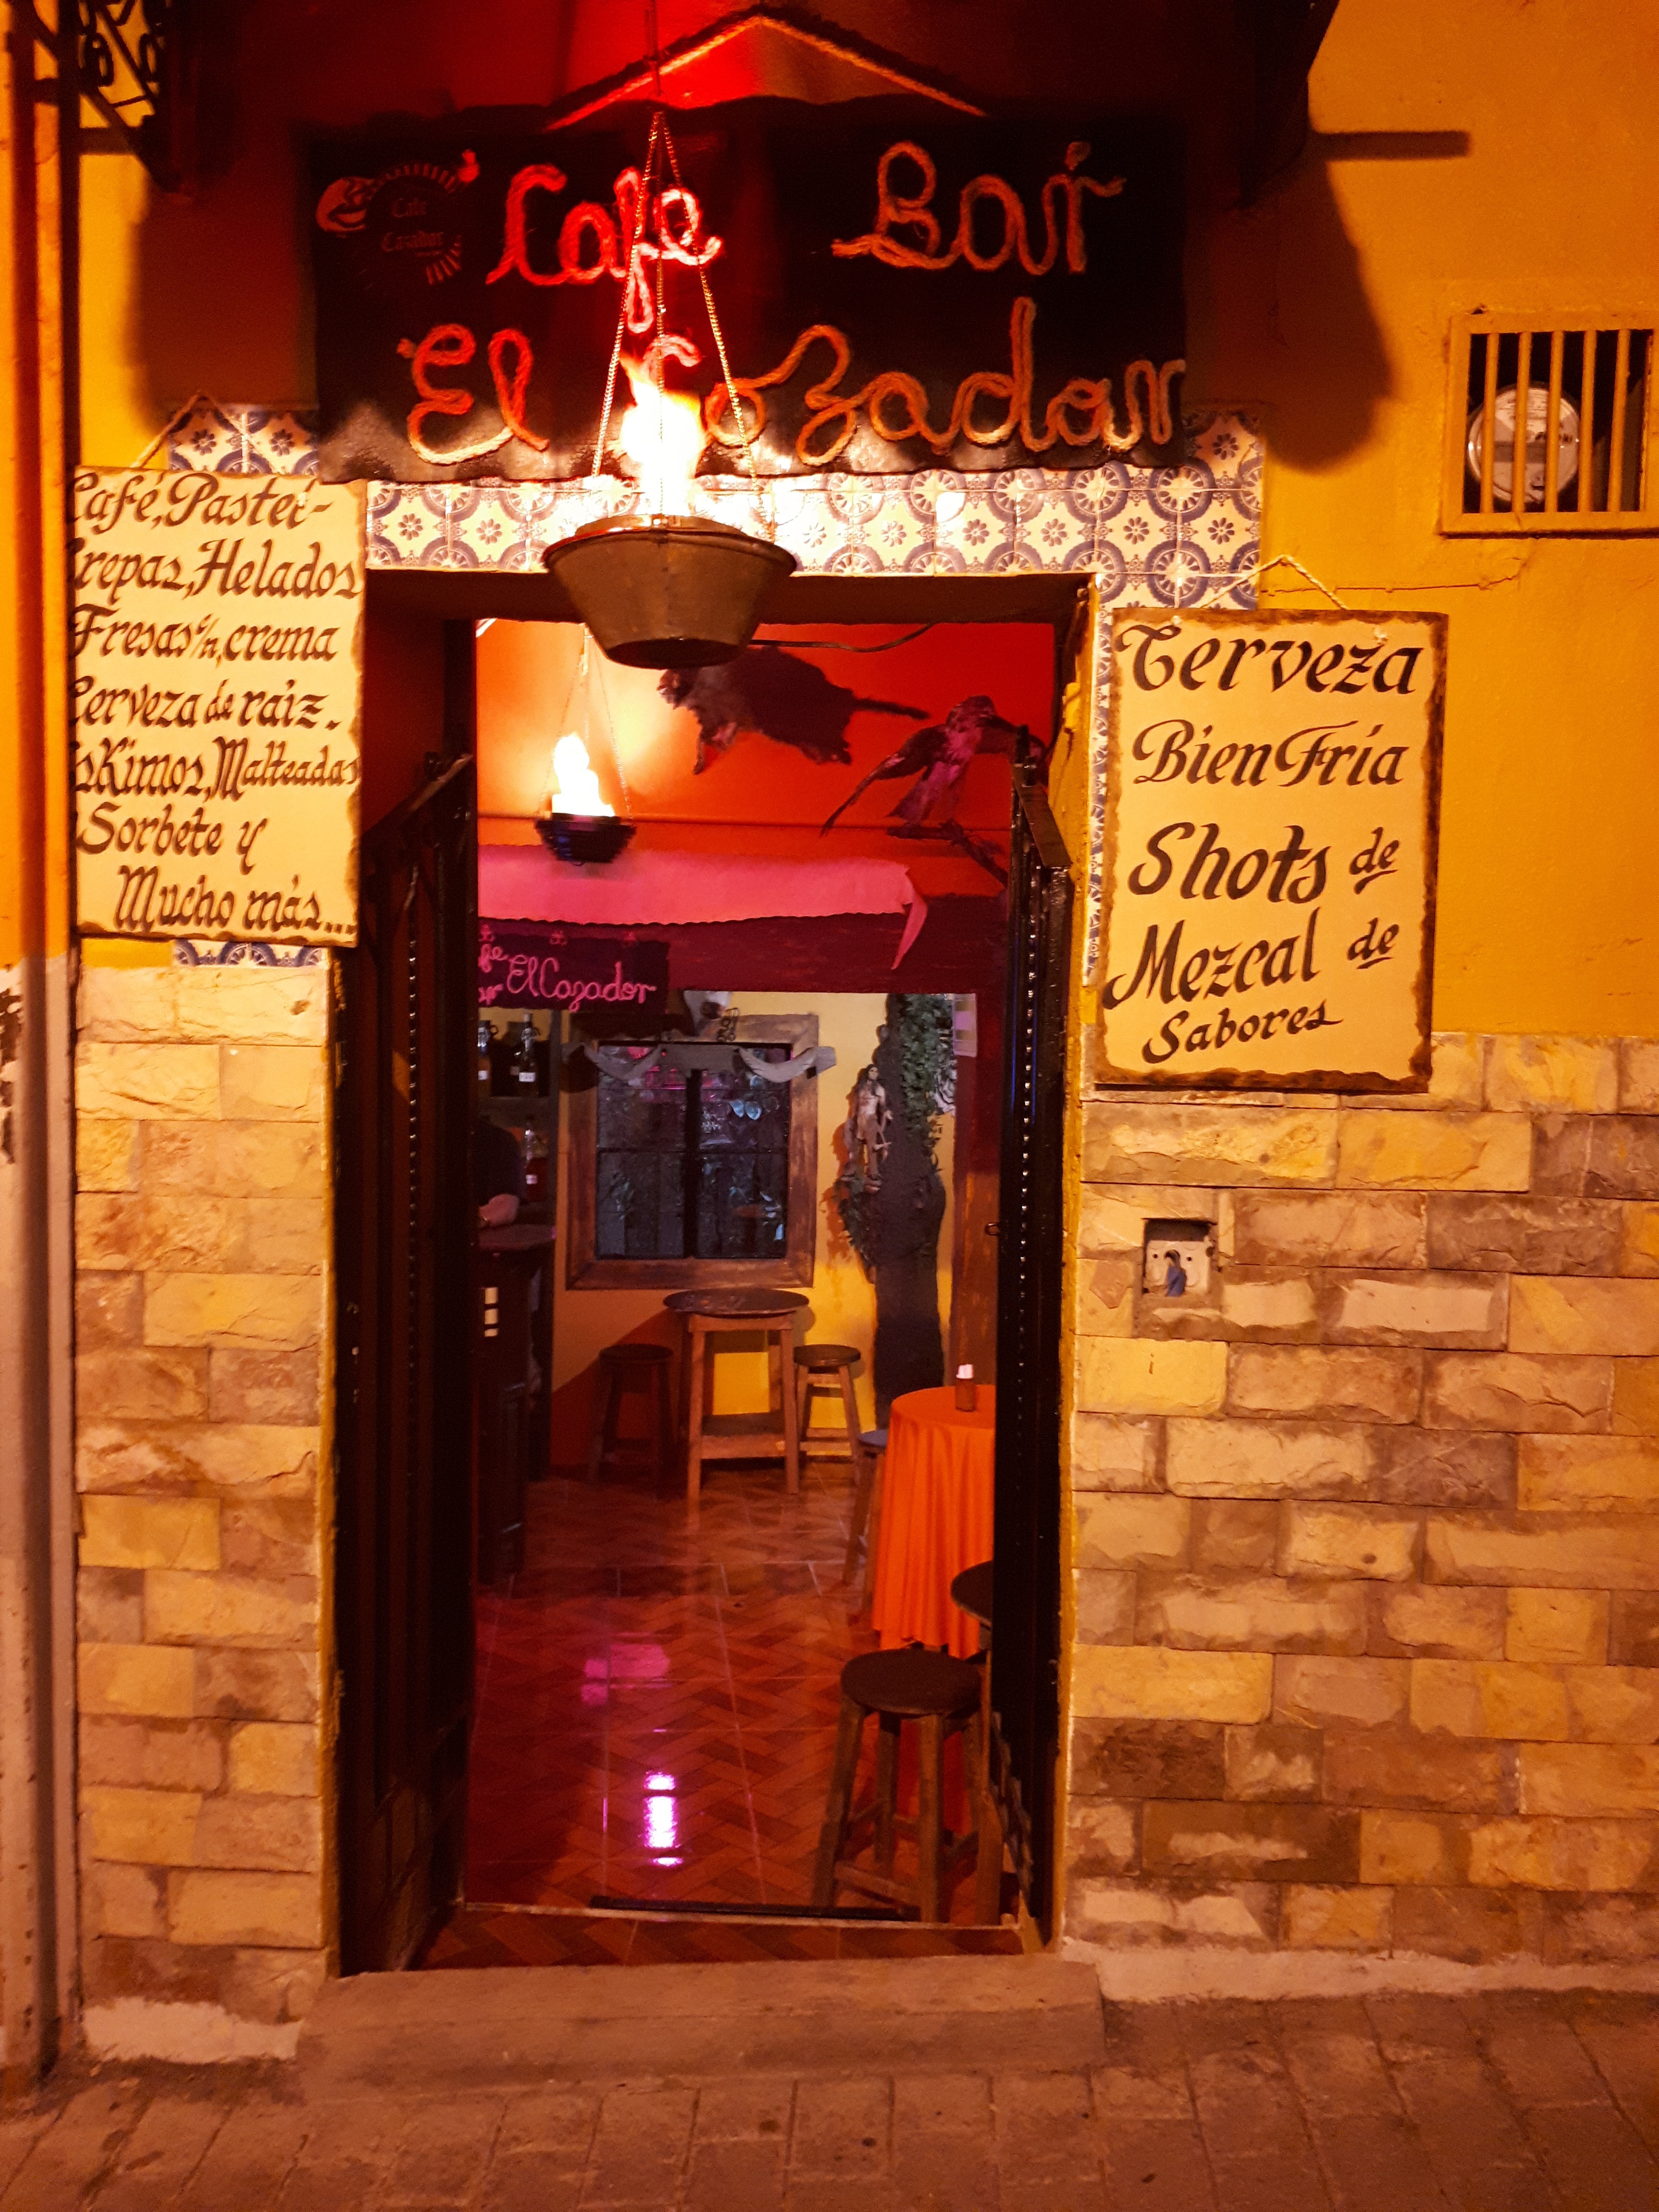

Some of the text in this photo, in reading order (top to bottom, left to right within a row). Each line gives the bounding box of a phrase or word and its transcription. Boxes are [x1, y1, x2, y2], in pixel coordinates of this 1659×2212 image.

[397, 324, 549, 466] El
[191, 538, 363, 600] Helados
[71, 603, 192, 659] Fresas
[223, 624, 340, 661] crema
[1117, 624, 1424, 695] Cerveza
[204, 679, 232, 724] de
[1132, 719, 1410, 787] Bien Fría
[76, 801, 267, 875] Sorbete y
[1128, 822, 1400, 904] Shots de
[113, 865, 235, 932] Mucho
[506, 954, 539, 997] El
[1103, 907, 1399, 1010] Mezcal de
[1142, 999, 1344, 1064] Sabores
